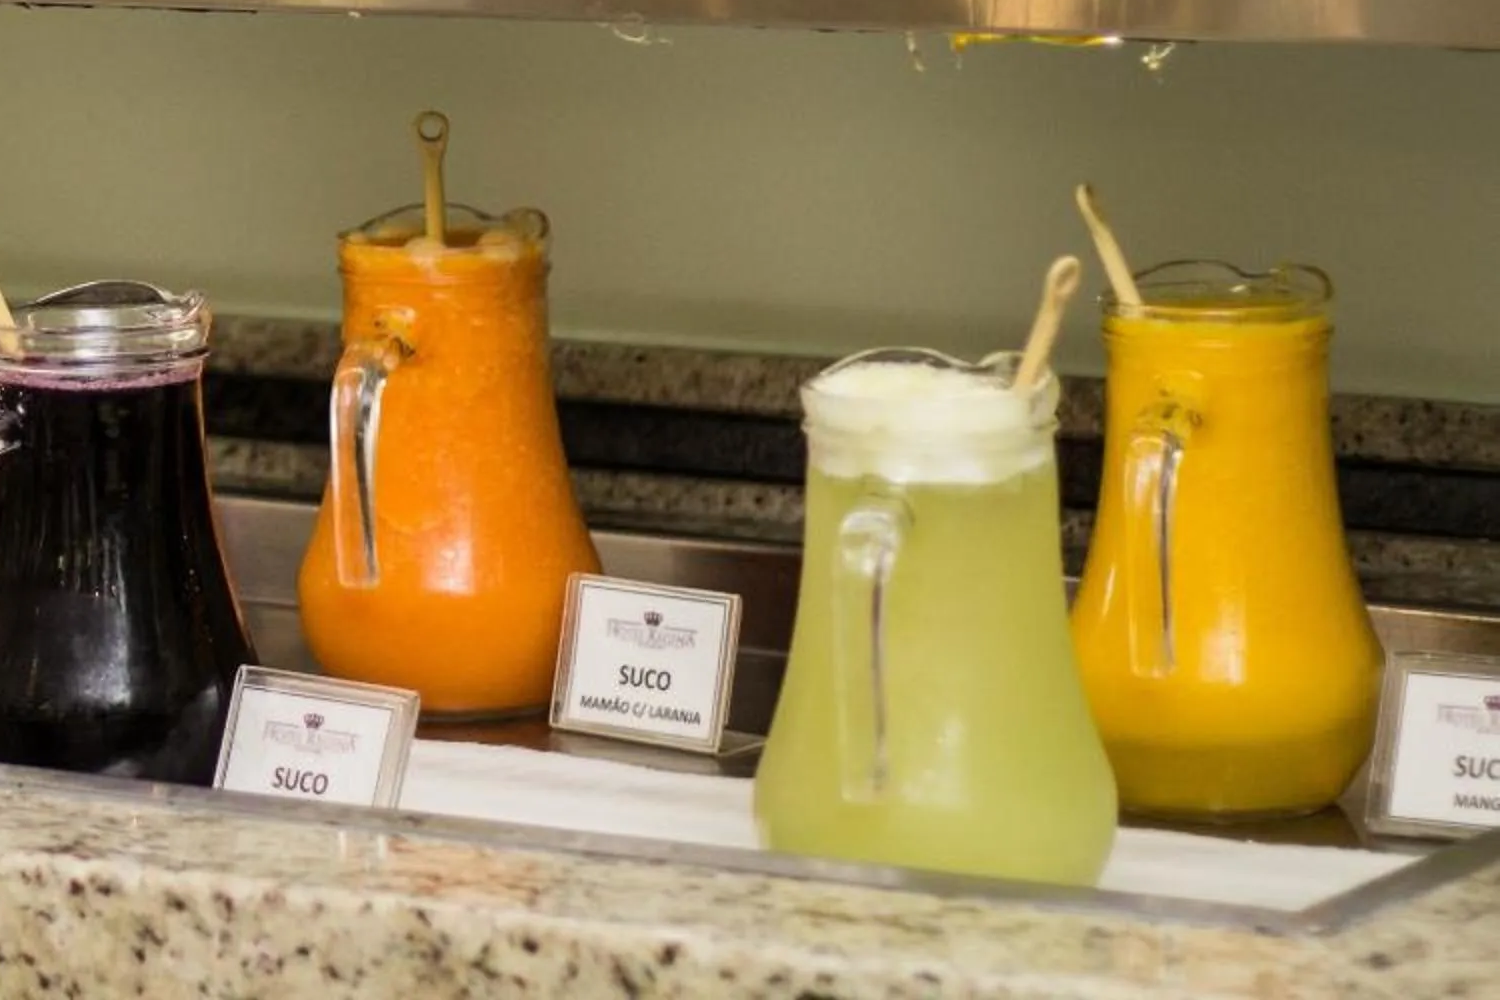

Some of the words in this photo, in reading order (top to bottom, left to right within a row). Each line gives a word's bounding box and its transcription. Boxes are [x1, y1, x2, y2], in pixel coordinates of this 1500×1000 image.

[619, 664, 671, 691] SUCO
[580, 695, 630, 715] MAMÃO
[649, 704, 701, 725] LARANJA
[271, 766, 329, 795] SUCO
